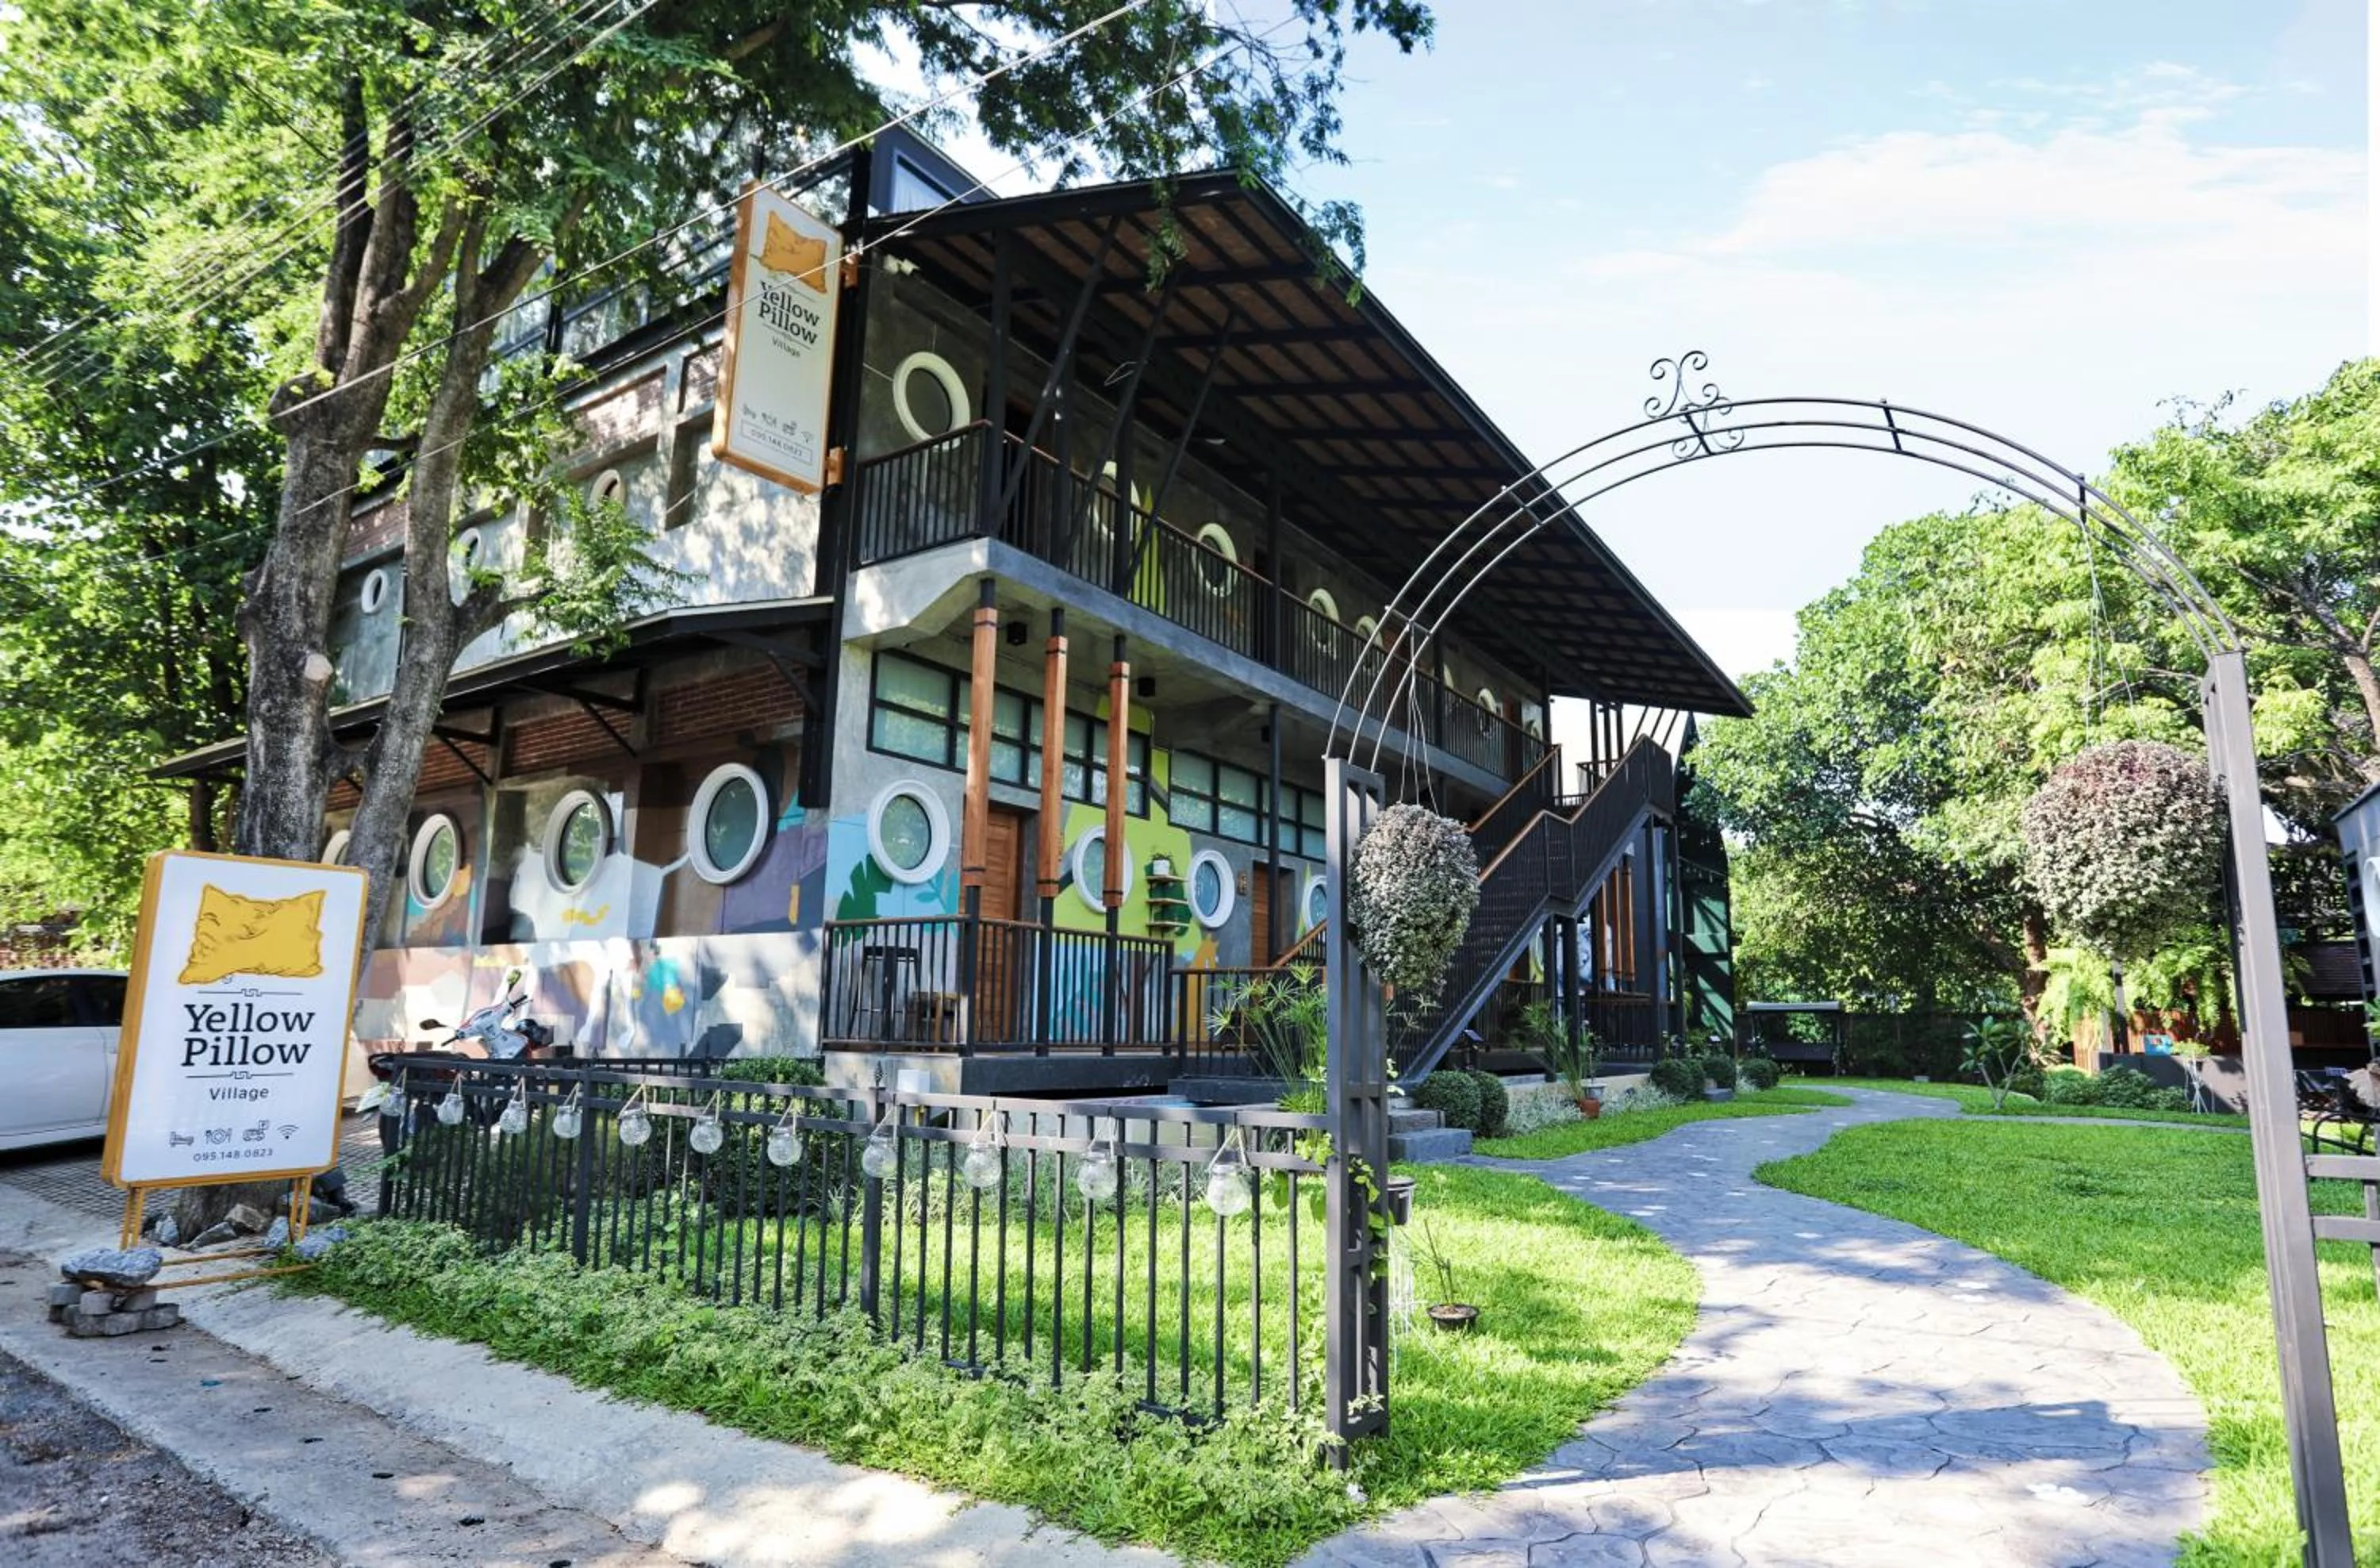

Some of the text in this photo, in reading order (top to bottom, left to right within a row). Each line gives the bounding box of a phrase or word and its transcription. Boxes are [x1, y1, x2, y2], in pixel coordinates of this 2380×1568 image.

[760, 279, 820, 326] Yellow
[758, 299, 818, 344] Pillow
[183, 1002, 316, 1032] Yellow
[180, 1035, 313, 1066] Pillow
[209, 1086, 270, 1102] Village
